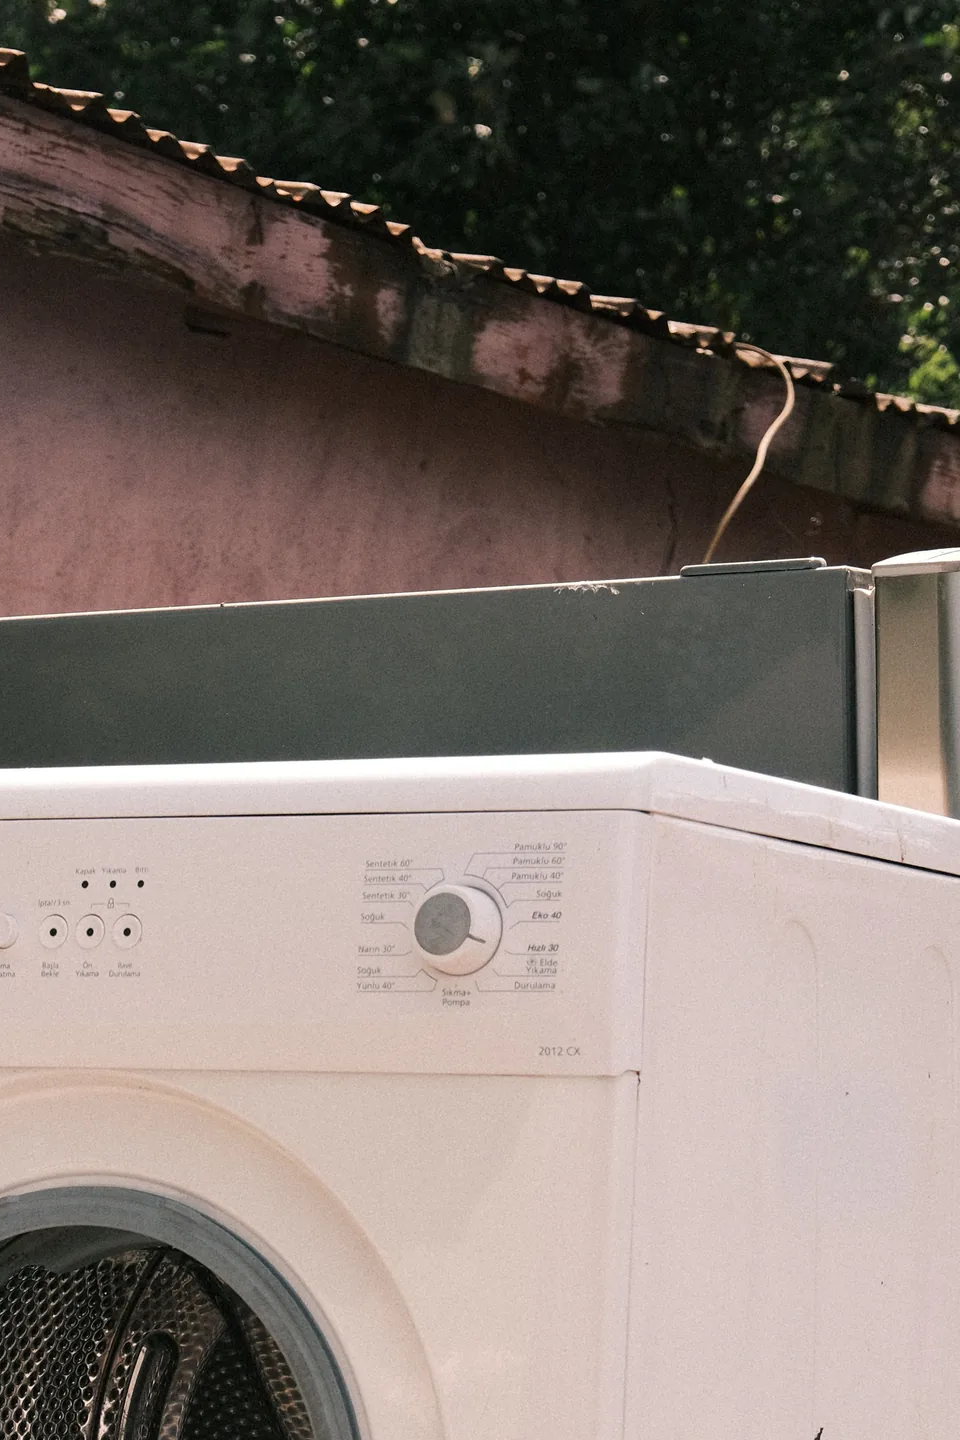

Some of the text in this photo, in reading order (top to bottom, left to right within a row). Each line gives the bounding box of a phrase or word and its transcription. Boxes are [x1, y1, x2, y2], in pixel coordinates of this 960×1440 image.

[514, 843, 551, 851] Pamuklu
[365, 860, 398, 868] Sentetik
[512, 857, 549, 865] Pamuklu
[364, 875, 395, 883] Sentetik
[511, 872, 548, 880] Pamuklu
[536, 890, 562, 900] Soğuk
[360, 912, 384, 921] Soğuk
[532, 911, 562, 919] Eko 40
[548, 944, 559, 952] 30
[357, 966, 381, 976] Soğuk
[514, 981, 556, 989] Durulama
[442, 999, 470, 1007] Pompa
[538, 1046, 580, 1056] 2012 CX
